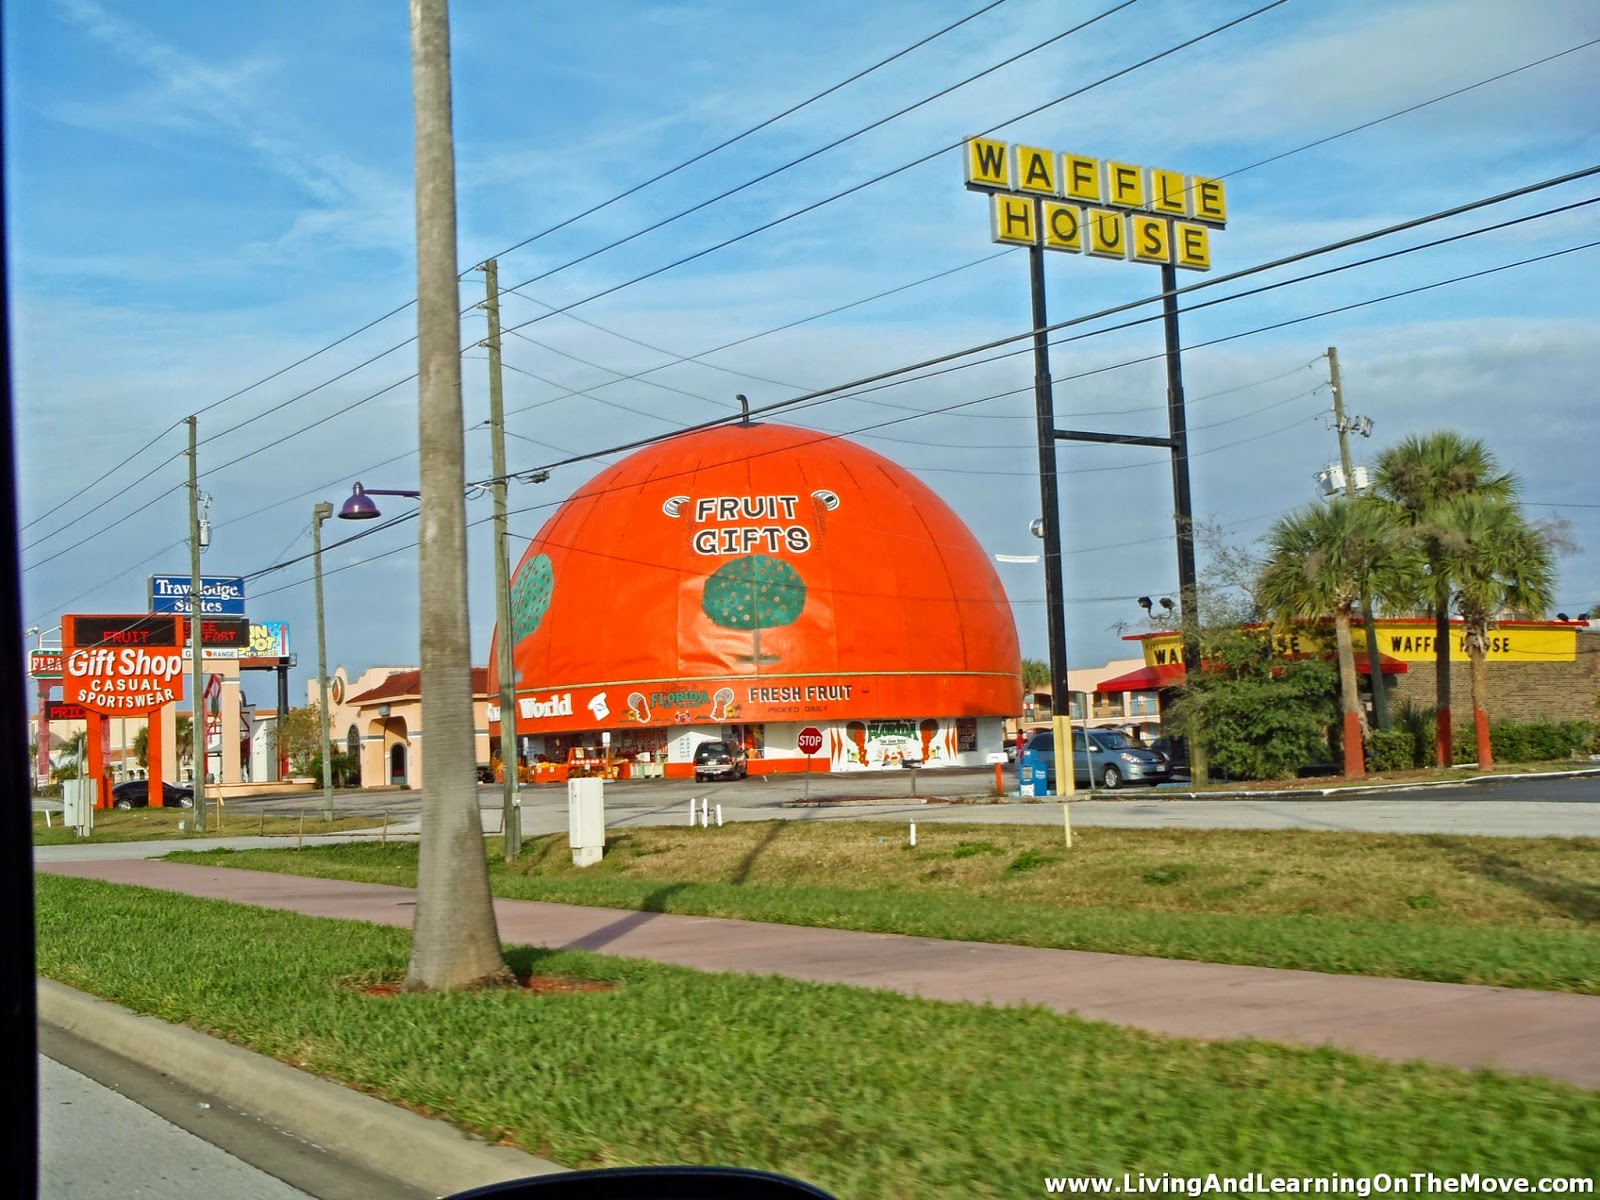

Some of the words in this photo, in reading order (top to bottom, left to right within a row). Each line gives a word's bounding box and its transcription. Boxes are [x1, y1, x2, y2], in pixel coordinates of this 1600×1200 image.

[975, 142, 1221, 215] WAFFLE
[1005, 201, 1205, 260] HOUSE
[695, 495, 799, 522] FRUIT
[693, 525, 811, 556] GIFTS
[156, 579, 239, 600] Travlodge
[174, 599, 222, 612] Sutes
[103, 630, 149, 643] FRUIT
[32, 657, 63, 671] FLEA
[68, 649, 116, 677] Gift
[118, 648, 182, 681] Shop
[90, 679, 163, 692] CASUAL
[748, 686, 802, 703] FRESH
[805, 685, 852, 702] FRUIT
[77, 688, 175, 708] SPORTSWEAR
[518, 693, 573, 719] World
[804, 705, 828, 713] DAILY
[798, 735, 822, 747] STOP
